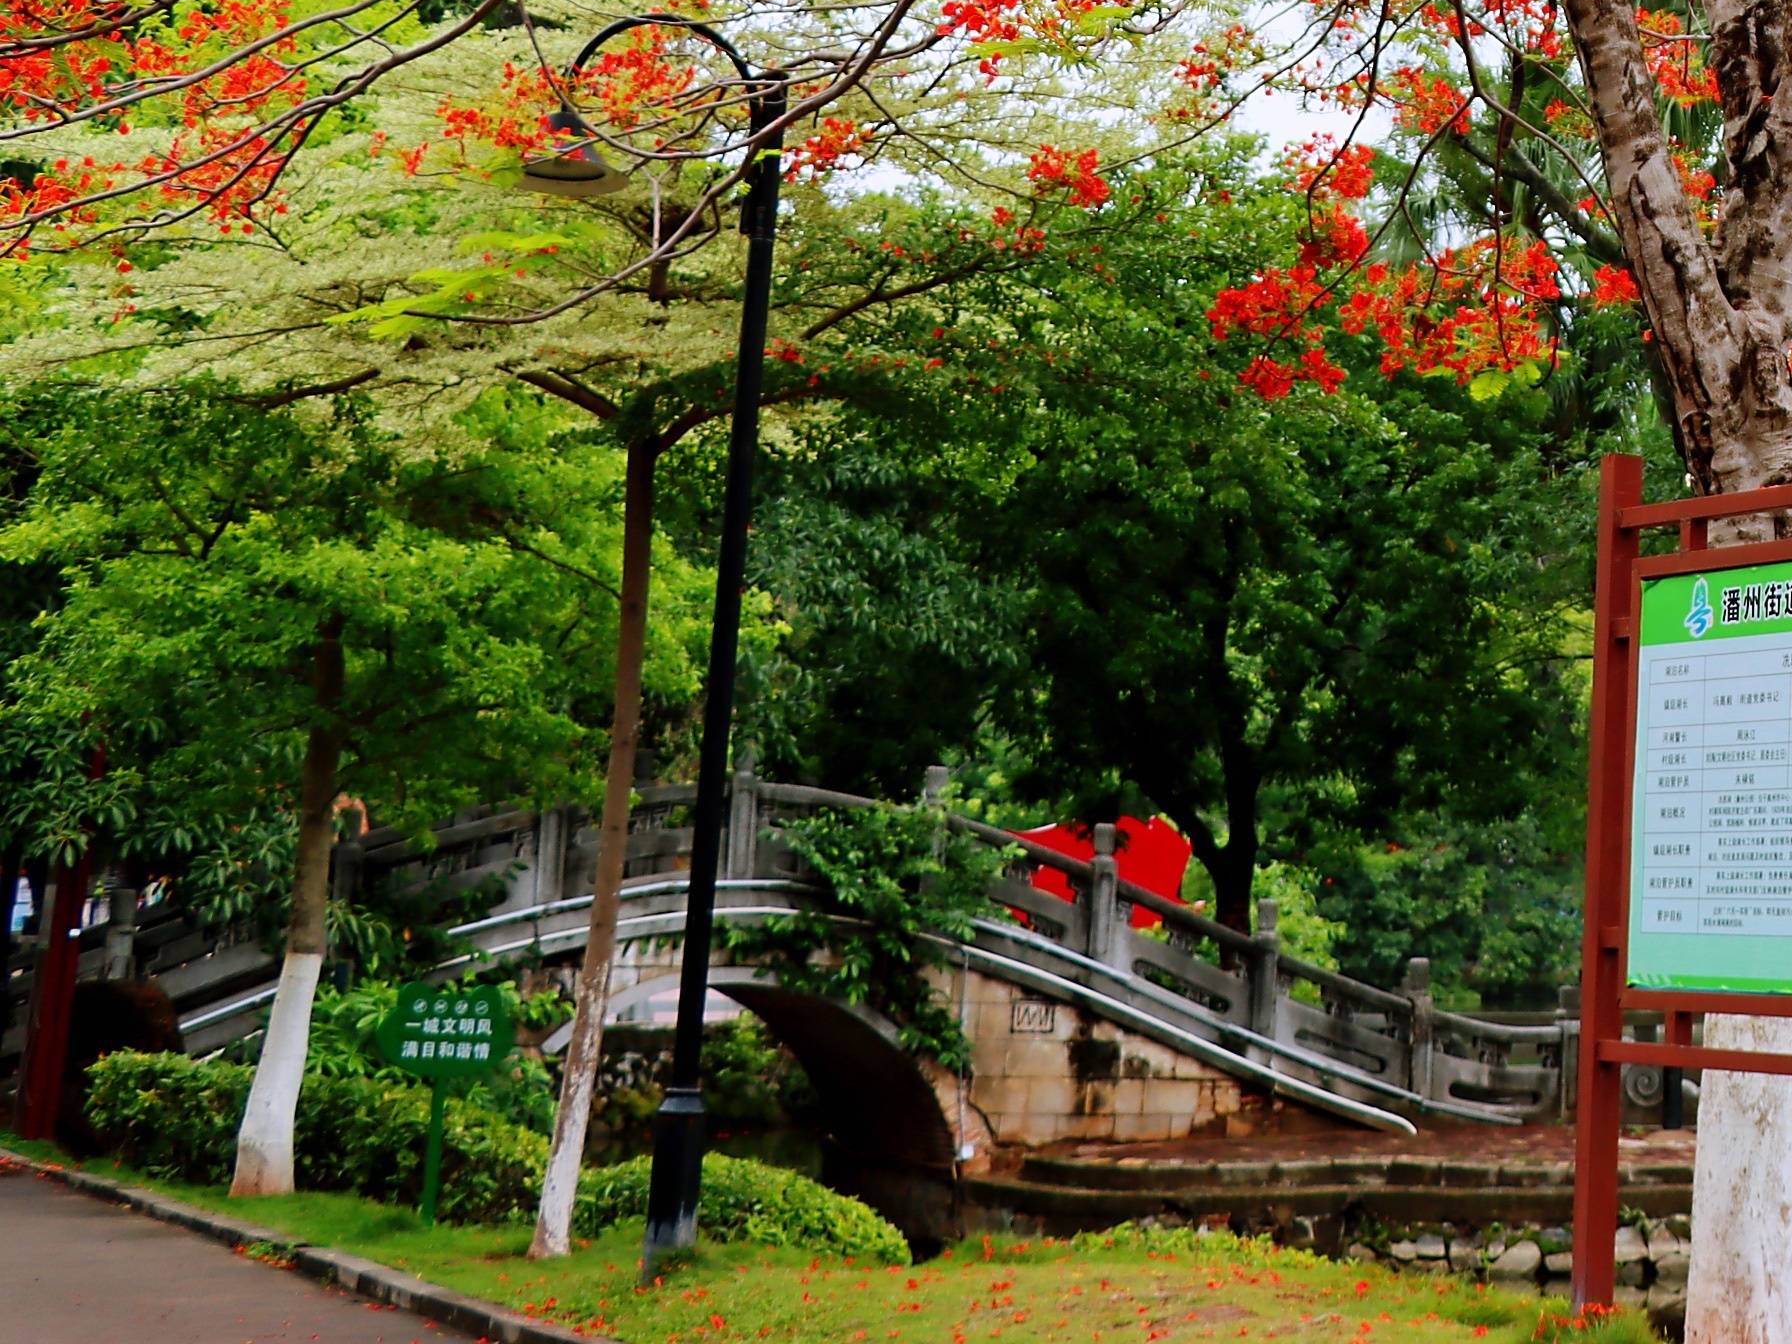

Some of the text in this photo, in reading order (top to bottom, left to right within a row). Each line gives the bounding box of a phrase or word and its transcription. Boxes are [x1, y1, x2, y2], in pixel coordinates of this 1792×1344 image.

[405, 1017, 493, 1036] 一城文明风
[401, 1040, 491, 1060] 满目和谐情
